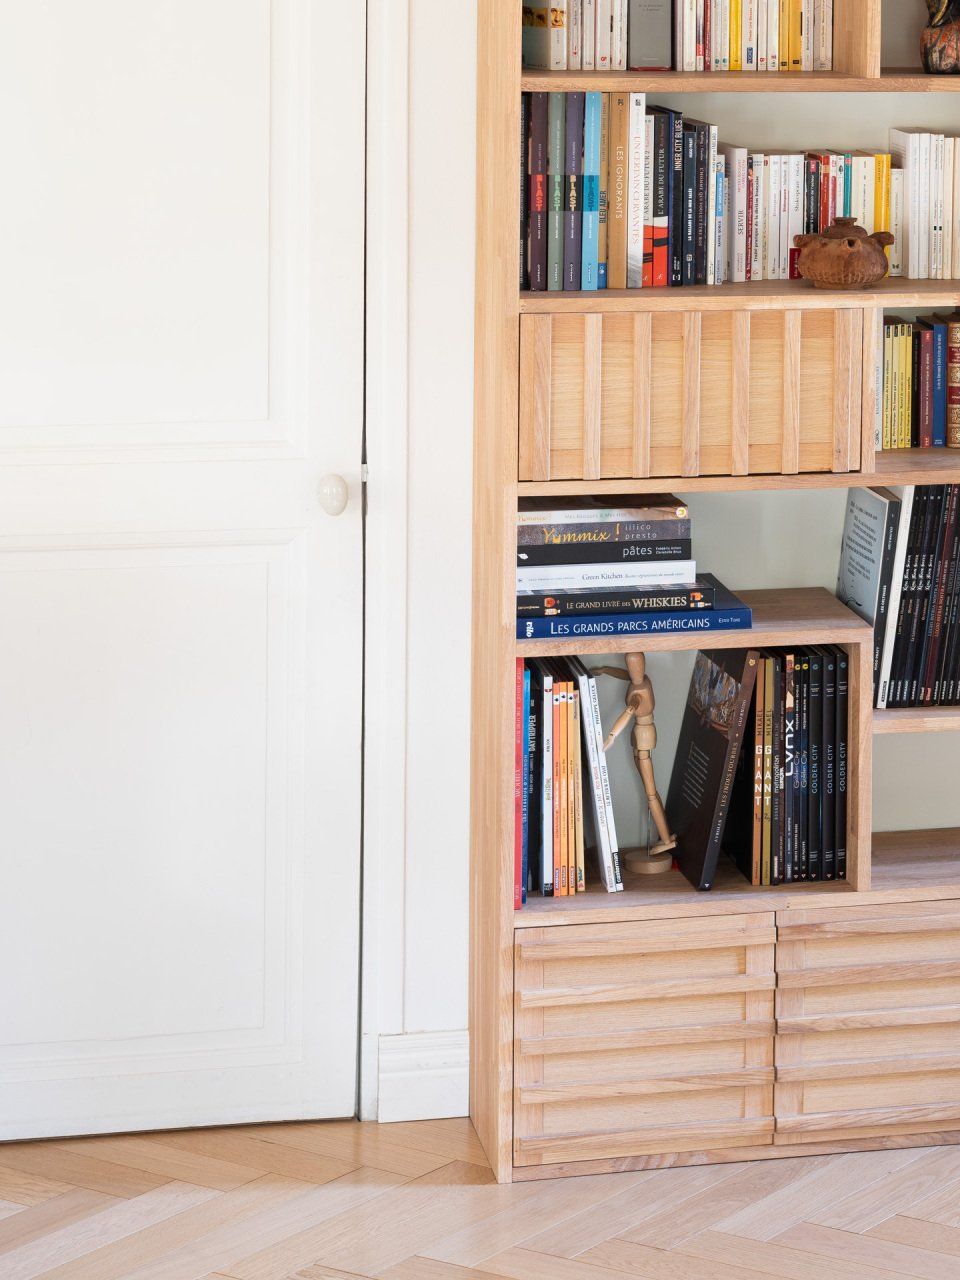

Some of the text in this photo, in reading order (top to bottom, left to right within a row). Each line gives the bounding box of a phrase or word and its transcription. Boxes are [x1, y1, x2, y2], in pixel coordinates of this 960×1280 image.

[674, 120, 682, 171] INNER CITY BLUES
[615, 146, 624, 219] LES IGNORANTS
[632, 136, 641, 245] UN CERTAIN CERVANTES
[643, 182, 650, 192] DU
[658, 175, 664, 185] DU
[536, 175, 544, 212] BLAST
[542, 528, 611, 544] Yummix
[625, 531, 657, 540] presto
[622, 546, 652, 558] pâtes
[582, 572, 623, 581] Green Kitchen
[575, 600, 600, 608] GRAND
[632, 596, 687, 608] WHISKIES
[550, 621, 569, 635] LES
[574, 622, 614, 633] GRANDS
[618, 621, 648, 632] PARCS
[651, 618, 710, 630] AMÉRICAINS
[528, 715, 536, 752] DAYTRIPPER
[723, 777, 732, 794] INDES
[728, 742, 738, 775] FOURBES
[754, 745, 763, 806] GIANT
[612, 853, 622, 884] casterman
